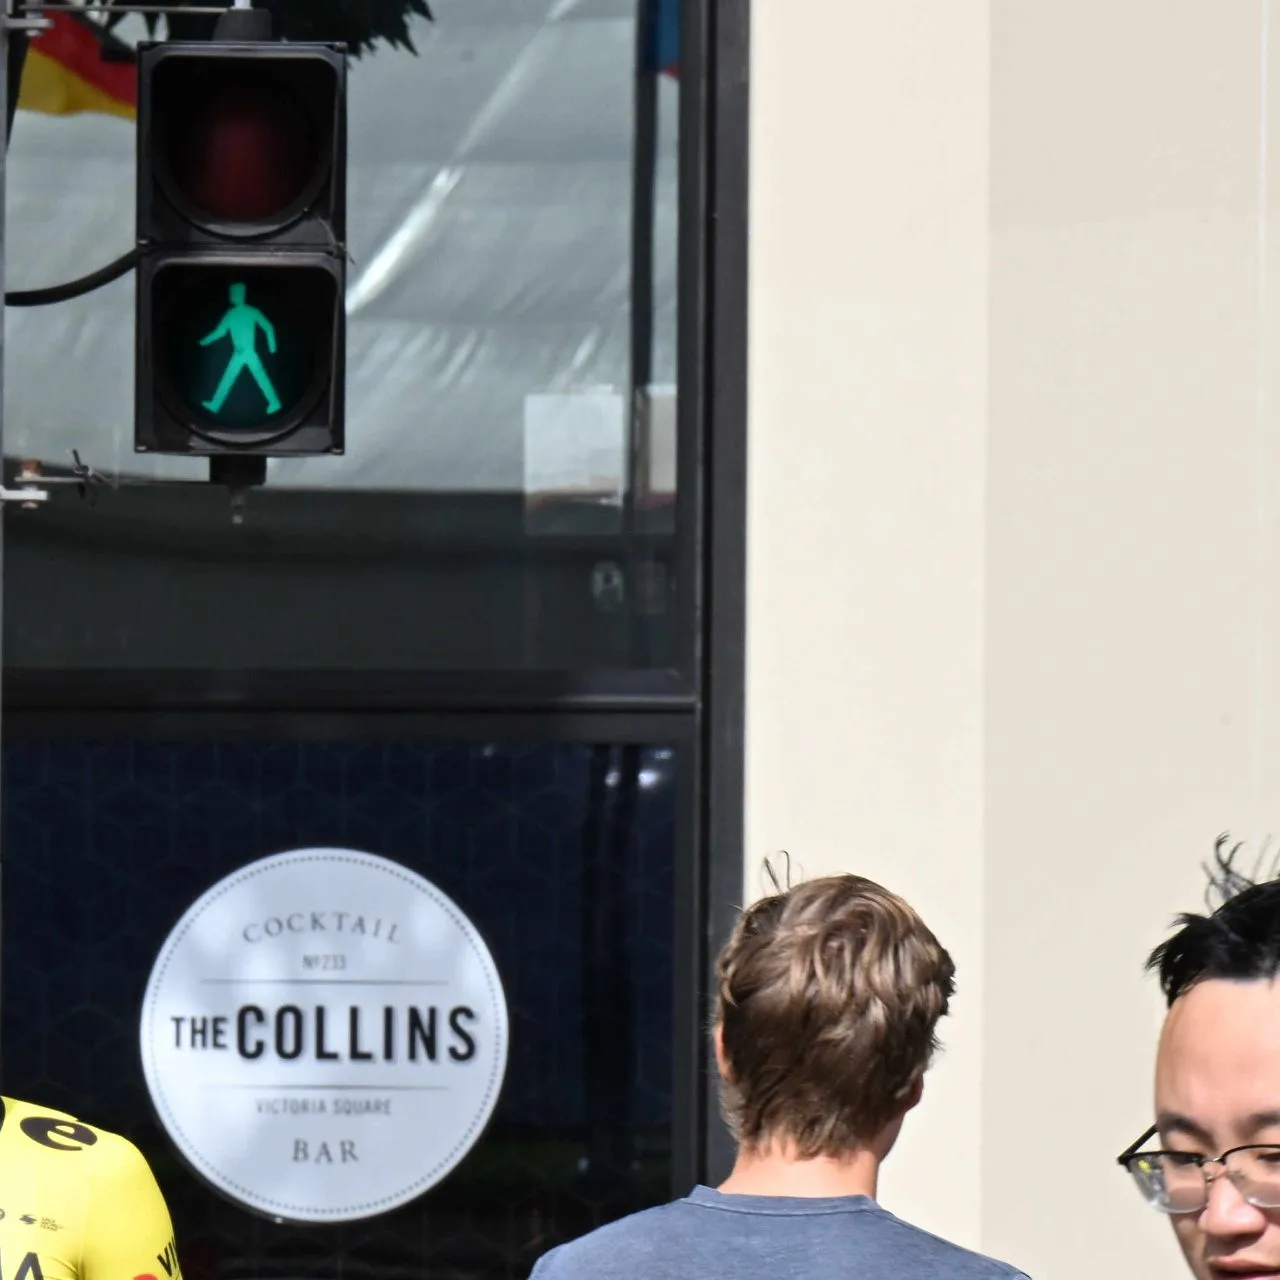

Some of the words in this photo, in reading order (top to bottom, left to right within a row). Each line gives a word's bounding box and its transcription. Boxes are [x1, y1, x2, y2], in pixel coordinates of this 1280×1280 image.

[242, 910, 401, 944] COCKTAIL
[170, 1016, 228, 1049] THE
[236, 1003, 477, 1063] COLLINS
[256, 1097, 327, 1115] VICTORIA
[333, 1098, 392, 1117] SQUARE
[291, 1138, 360, 1164] BAR
